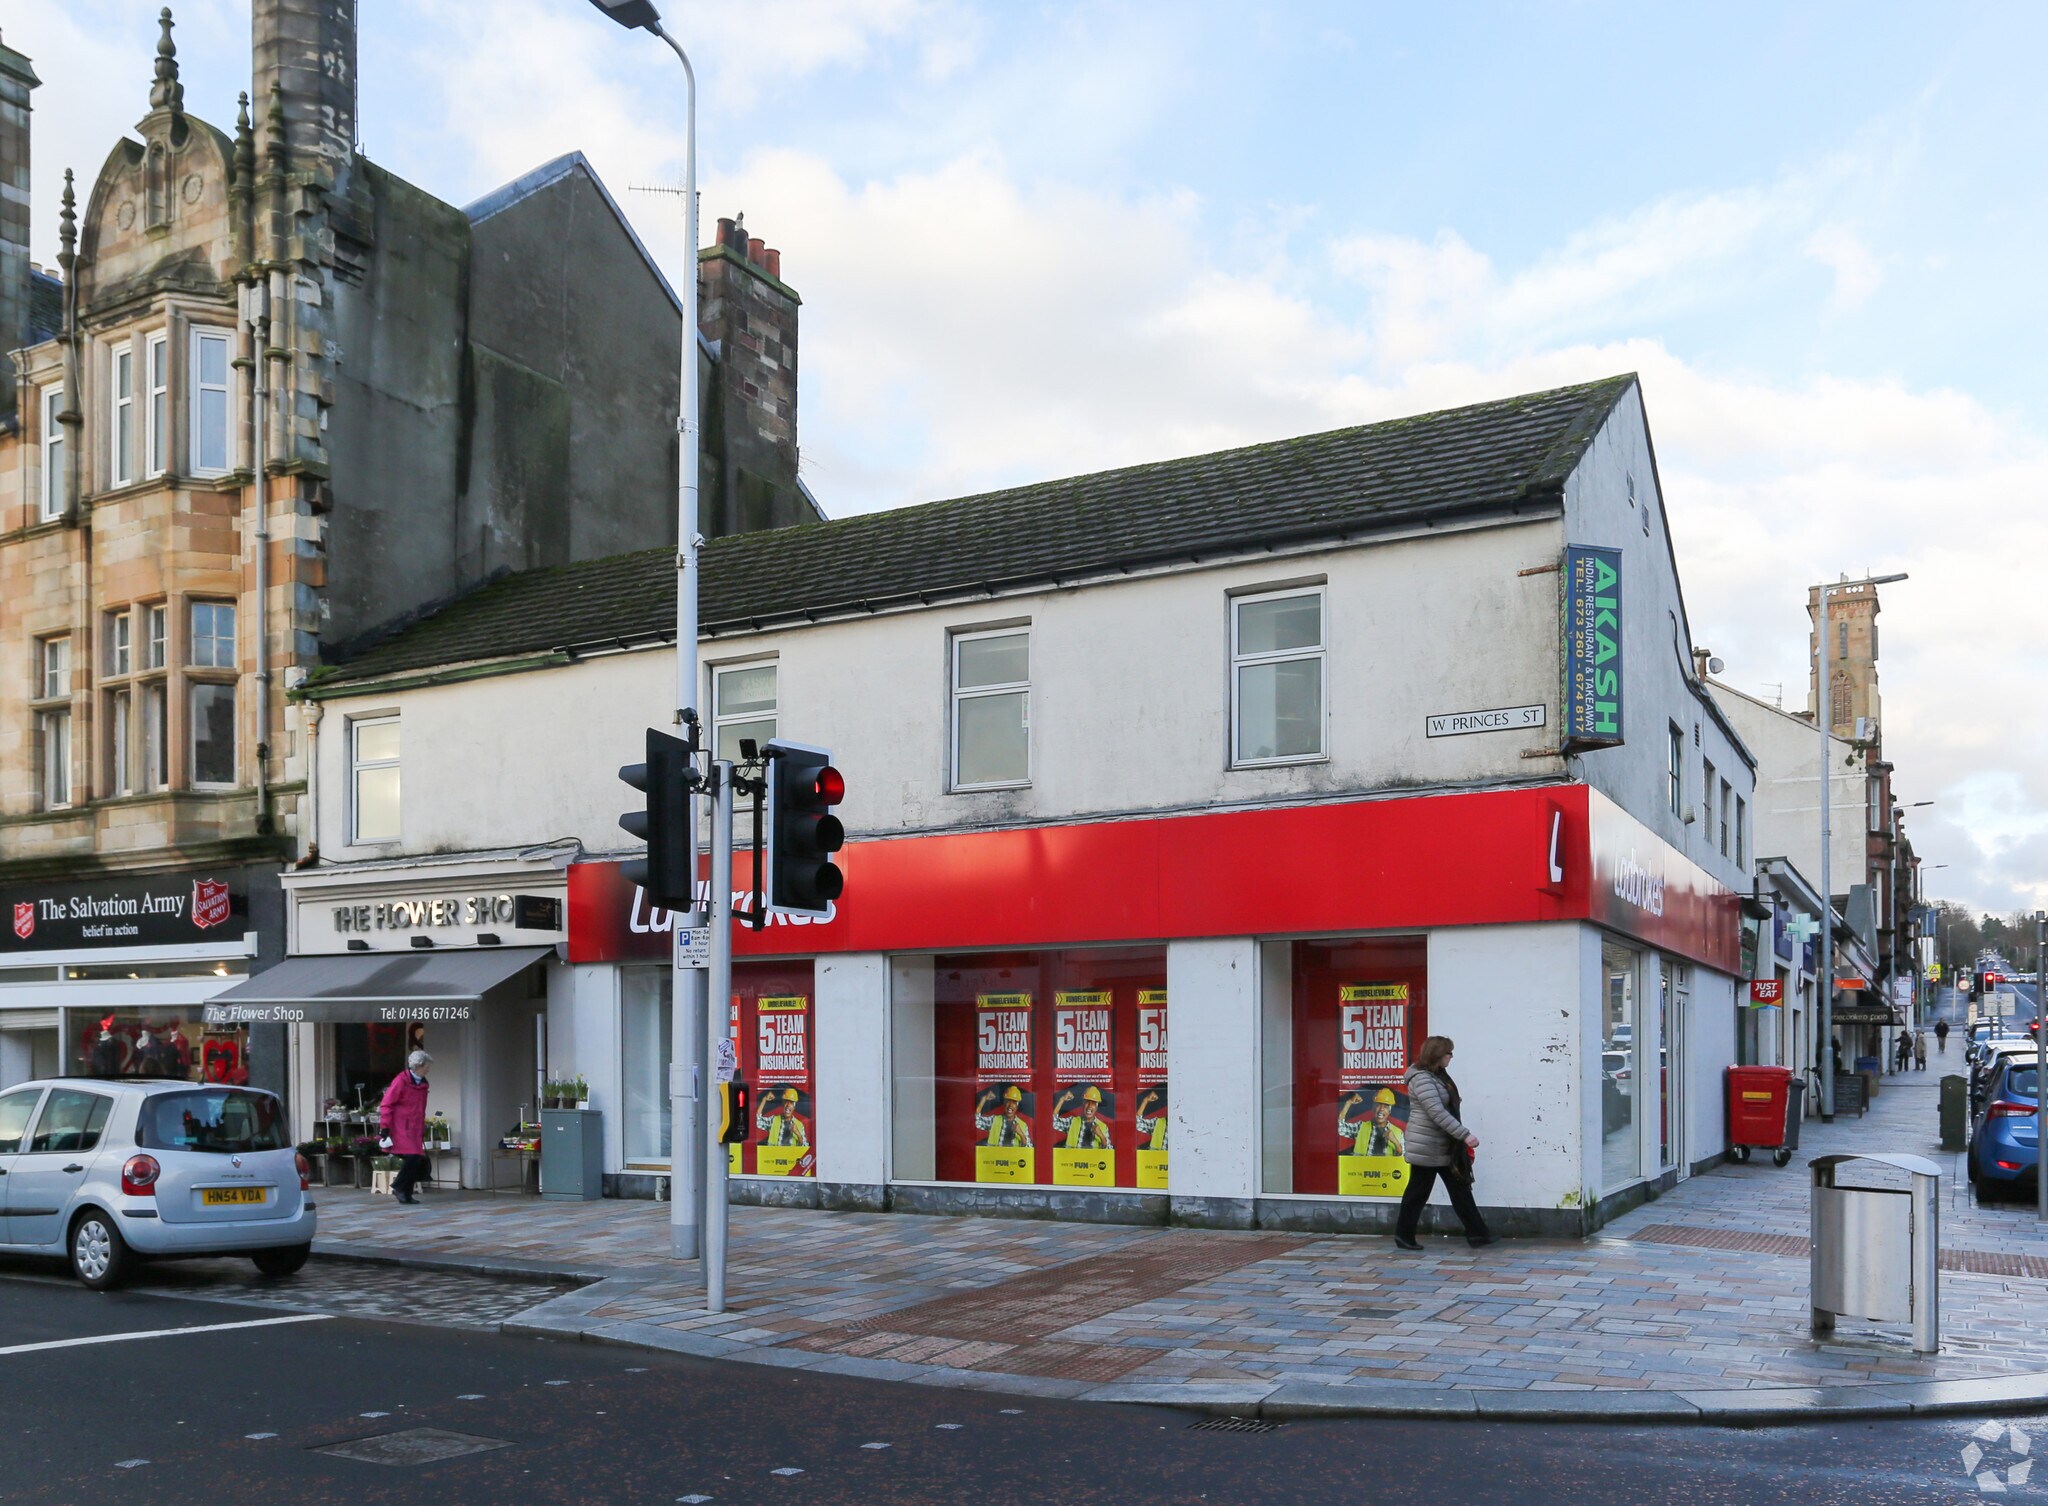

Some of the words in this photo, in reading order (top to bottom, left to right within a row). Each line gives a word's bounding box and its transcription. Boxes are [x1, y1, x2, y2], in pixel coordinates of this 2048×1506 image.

[1575, 558, 1584, 593] TEL:
[1585, 558, 1594, 593] INDIAN
[1575, 600, 1584, 626] 673
[1585, 596, 1594, 664] RESTAURANT
[1575, 631, 1584, 658] 260
[1595, 558, 1618, 734] AKASH
[1575, 675, 1584, 700] 674
[1585, 676, 1594, 733] TAKEAWAY
[1432, 719, 1446, 731] W
[1452, 713, 1509, 730] PRINCES
[1522, 710, 1540, 723] ST
[1575, 705, 1584, 732] 817
[39, 899, 66, 921] The
[70, 894, 138, 918] Salvation
[141, 892, 185, 918] Army
[330, 904, 370, 932] THE
[374, 899, 460, 930] FLOWER
[464, 894, 515, 924] SHO
[82, 925, 104, 938] belief
[106, 924, 113, 936] in
[114, 923, 138, 936] action
[1755, 983, 1777, 991] JUST
[207, 1007, 226, 1021] The
[230, 1006, 269, 1020] Flower
[273, 1006, 304, 1022] Shop
[381, 1008, 396, 1019] Tel:
[399, 1007, 430, 1019] 01436
[432, 1007, 469, 1019] 671246
[760, 1015, 775, 1054] 5
[775, 1014, 804, 1034] TEAM
[979, 1012, 996, 1052] 5
[996, 1012, 1028, 1031] TEAM
[1056, 1011, 1074, 1052] 5
[1074, 1010, 1108, 1031] TEAM
[1140, 1009, 1159, 1051] 5
[1343, 1006, 1364, 1050] 5
[1364, 1005, 1404, 1027] TEAM
[1365, 1029, 1404, 1050] ACCA
[776, 1035, 804, 1054] ACCA
[997, 1033, 1028, 1052] ACCA
[1075, 1032, 1108, 1052] ACCA
[760, 1056, 804, 1070] INSURANCE
[979, 1053, 1028, 1069] INSURANCE
[1057, 1053, 1108, 1069] INSURANCE
[1343, 1052, 1404, 1069] INSURANCE
[208, 1191, 237, 1202] HN54
[241, 1190, 261, 1201] VDA
